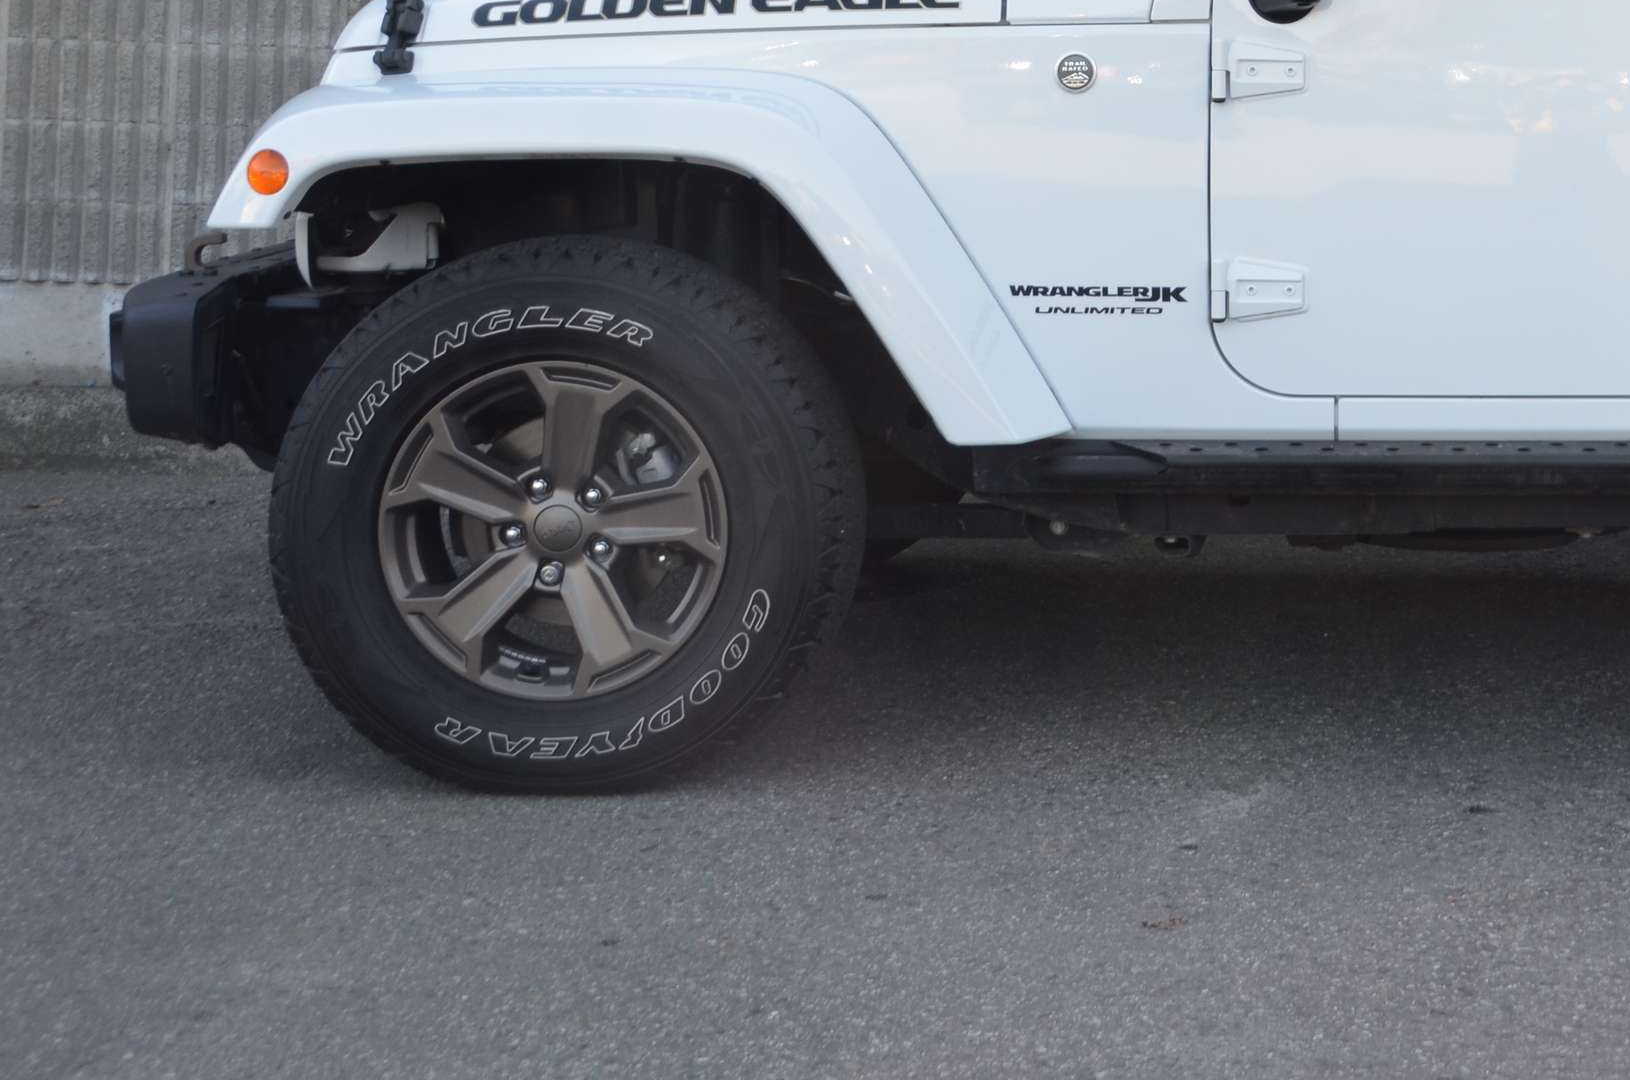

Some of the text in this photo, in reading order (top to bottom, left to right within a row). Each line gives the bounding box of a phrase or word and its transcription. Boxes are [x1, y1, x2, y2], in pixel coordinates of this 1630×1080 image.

[327, 306, 655, 466] WRANGLER
[1035, 306, 1163, 314] UNLIMITED
[433, 589, 771, 759] GOODYEAR
